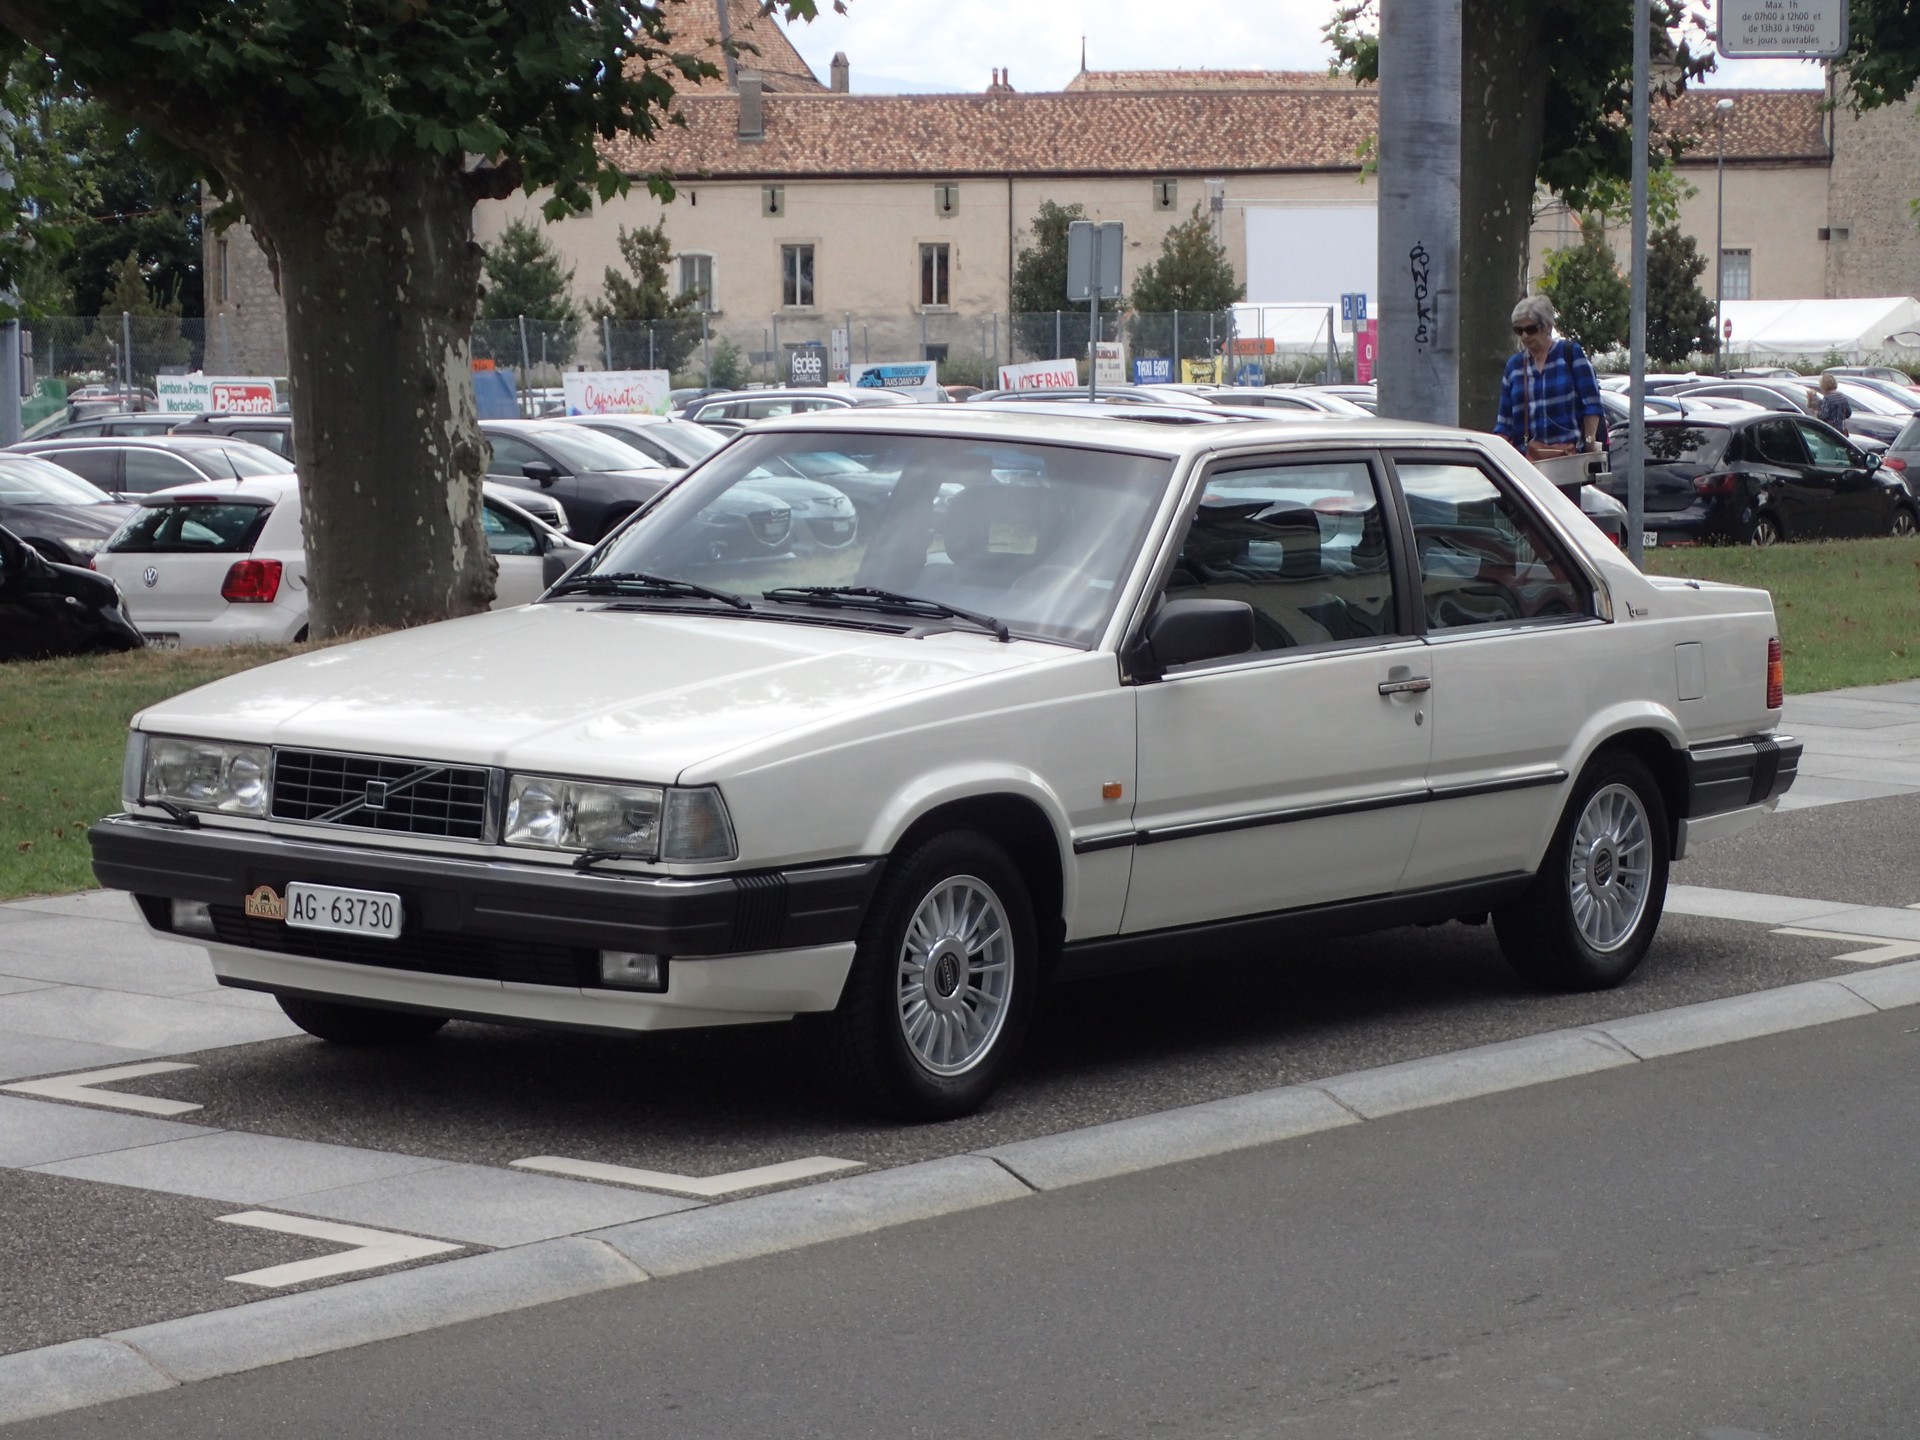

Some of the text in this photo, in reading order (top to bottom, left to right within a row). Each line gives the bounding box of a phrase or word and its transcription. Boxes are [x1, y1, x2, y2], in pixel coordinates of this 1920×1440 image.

[1788, 1, 1798, 9] 1h
[1741, 12, 1821, 21] de 07h00 à 12h00 et
[1748, 23, 1815, 32] de 13h30 à 19h00
[1742, 35, 1820, 46] les jours ouvrables
[791, 351, 822, 374] fedele
[1136, 360, 1152, 376] TAXI
[1153, 360, 1169, 377] EASY
[791, 374, 821, 383] CARRELAGE
[883, 377, 898, 386] TAXIS
[159, 381, 182, 395] Jambon
[189, 381, 208, 395] Parme
[166, 397, 204, 412] Mortadella
[214, 388, 272, 413] Beretta
[584, 384, 635, 413] Capriati
[247, 898, 282, 917] FABAM
